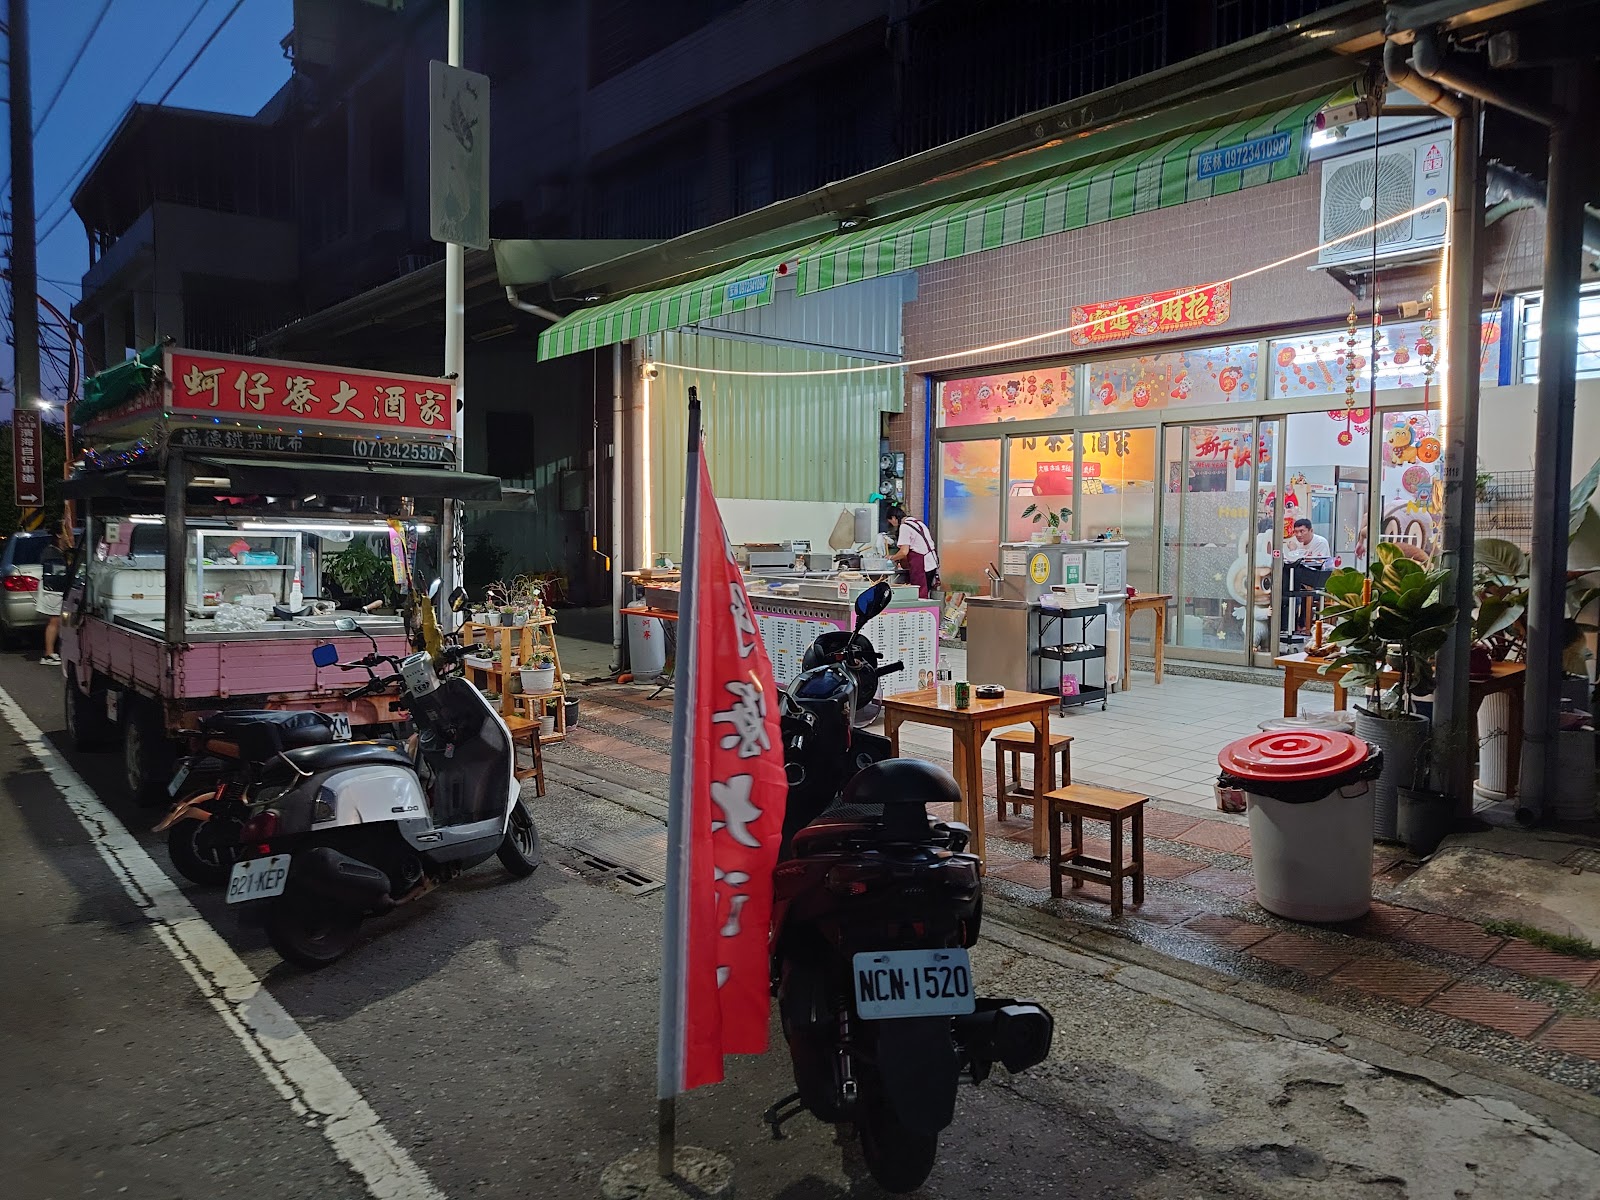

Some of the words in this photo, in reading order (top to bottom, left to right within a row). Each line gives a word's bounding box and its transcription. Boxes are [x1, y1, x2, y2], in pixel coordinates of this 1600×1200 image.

[1224, 137, 1285, 168] 0972341098
[183, 365, 446, 425] 蚵仔寮大酒家
[352, 439, 445, 461] (07)3425587
